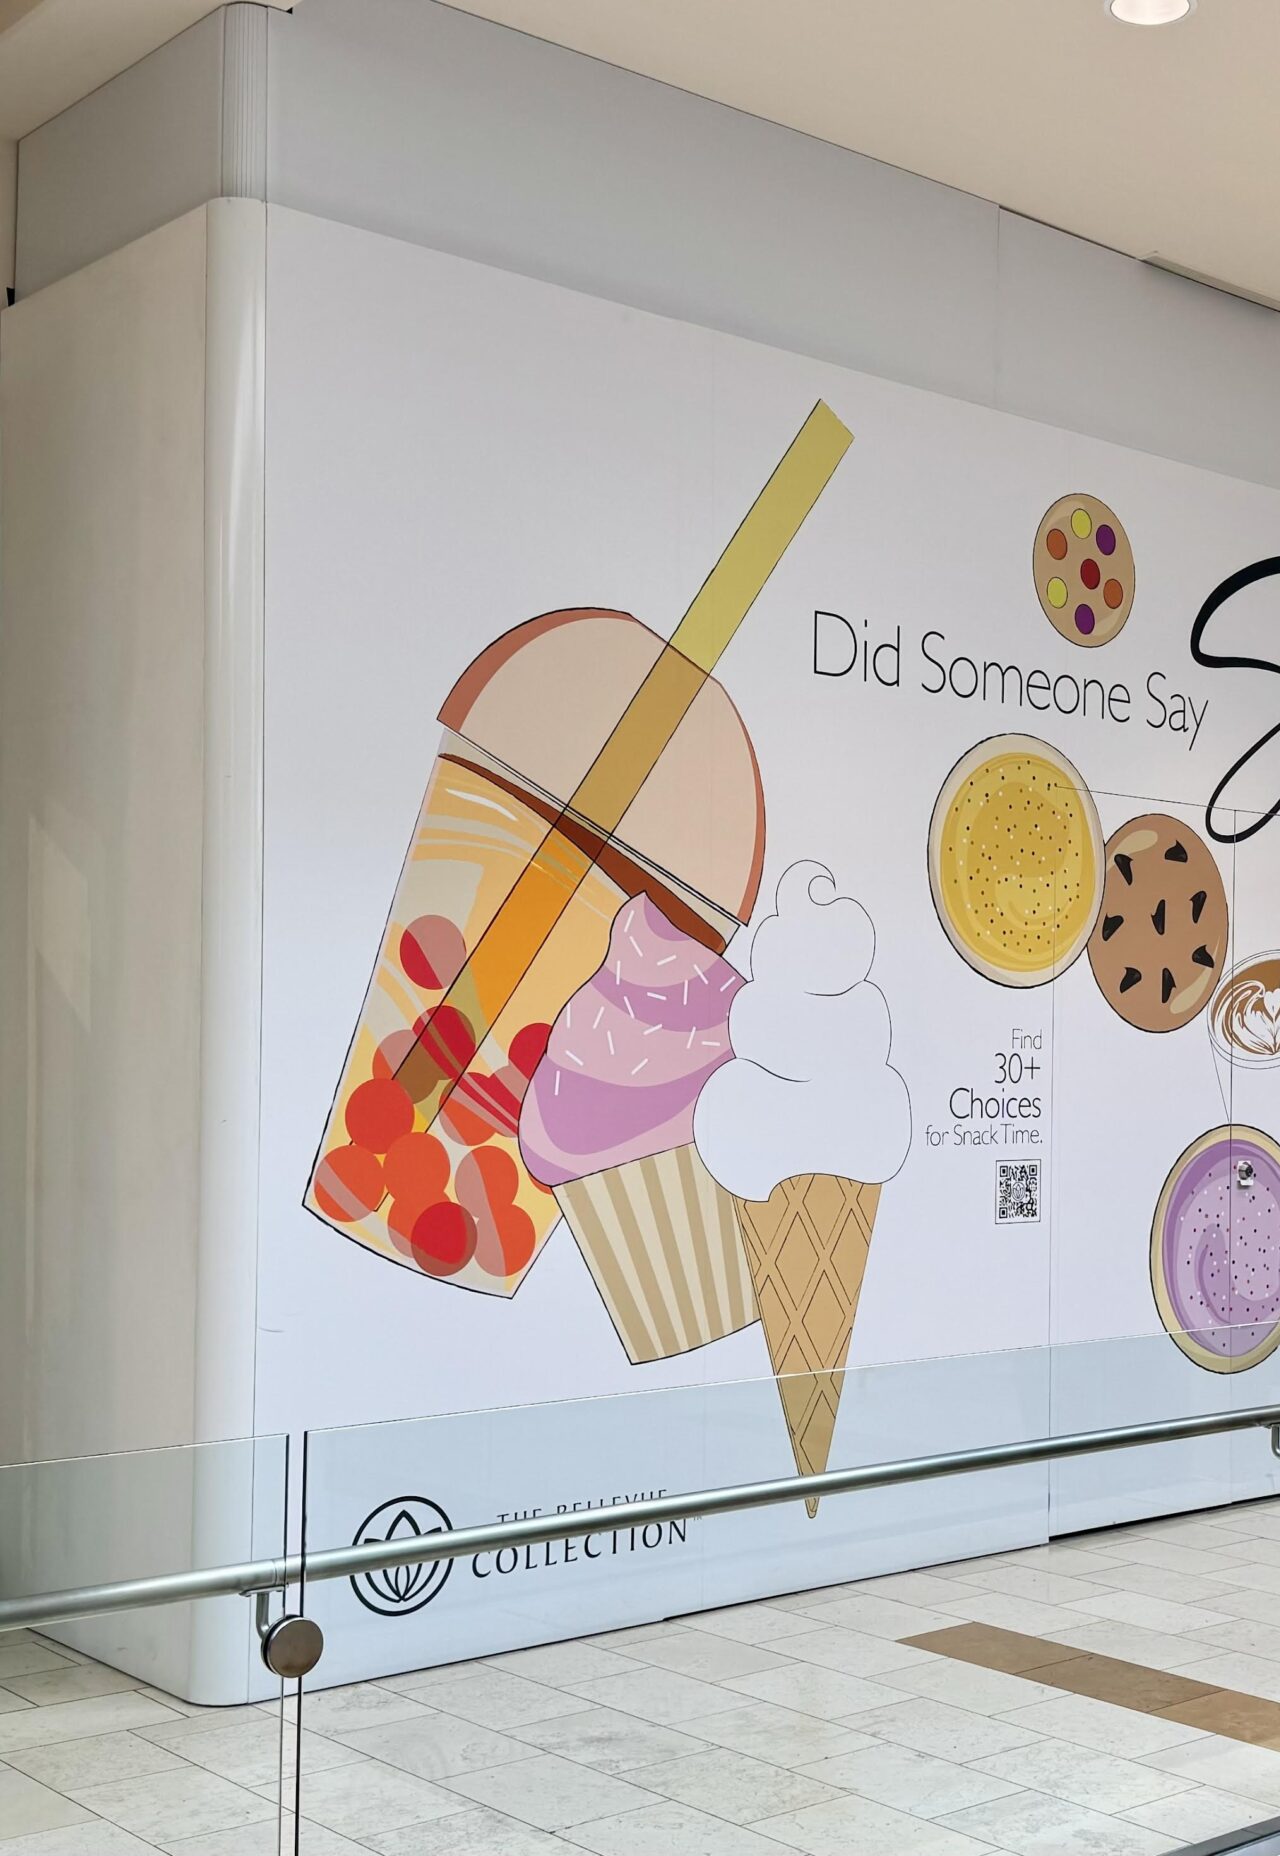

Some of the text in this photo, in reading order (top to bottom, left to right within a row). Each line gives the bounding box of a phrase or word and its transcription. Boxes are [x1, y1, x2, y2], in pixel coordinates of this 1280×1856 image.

[813, 610, 900, 688] Did
[920, 630, 1131, 723] Someone
[1145, 672, 1209, 752] Say
[1011, 1028, 1042, 1049] Find
[994, 1052, 1041, 1084] 30+
[949, 1087, 1042, 1119] Choices
[925, 1123, 1043, 1146] for Snack Time.
[471, 1518, 687, 1579] COLLECTION
